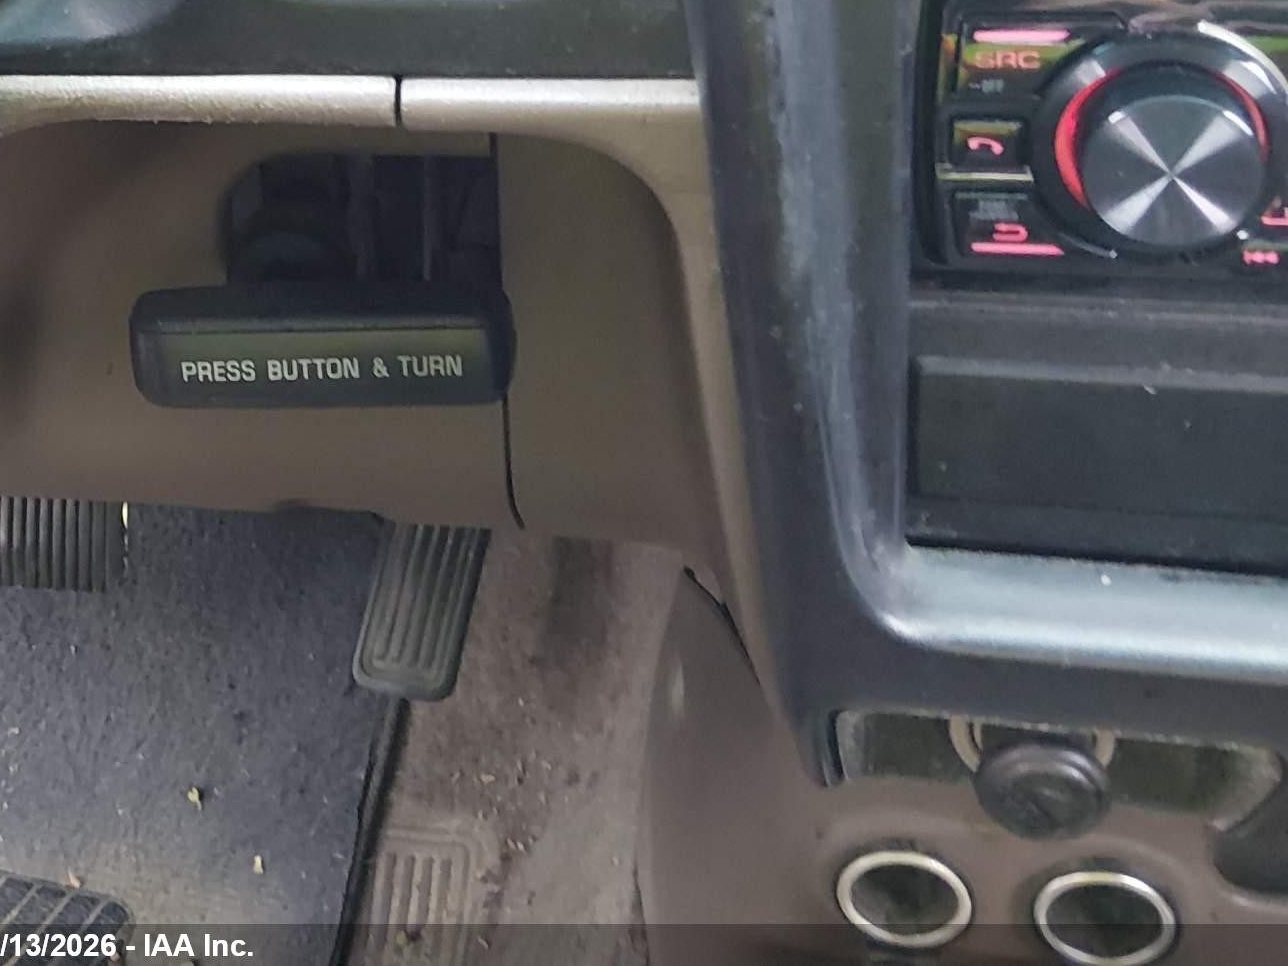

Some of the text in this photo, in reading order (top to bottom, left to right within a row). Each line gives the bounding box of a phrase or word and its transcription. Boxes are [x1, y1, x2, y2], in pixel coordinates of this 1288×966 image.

[975, 50, 1041, 69] SRC
[181, 355, 463, 382] PRESS BUTTON & TURN
